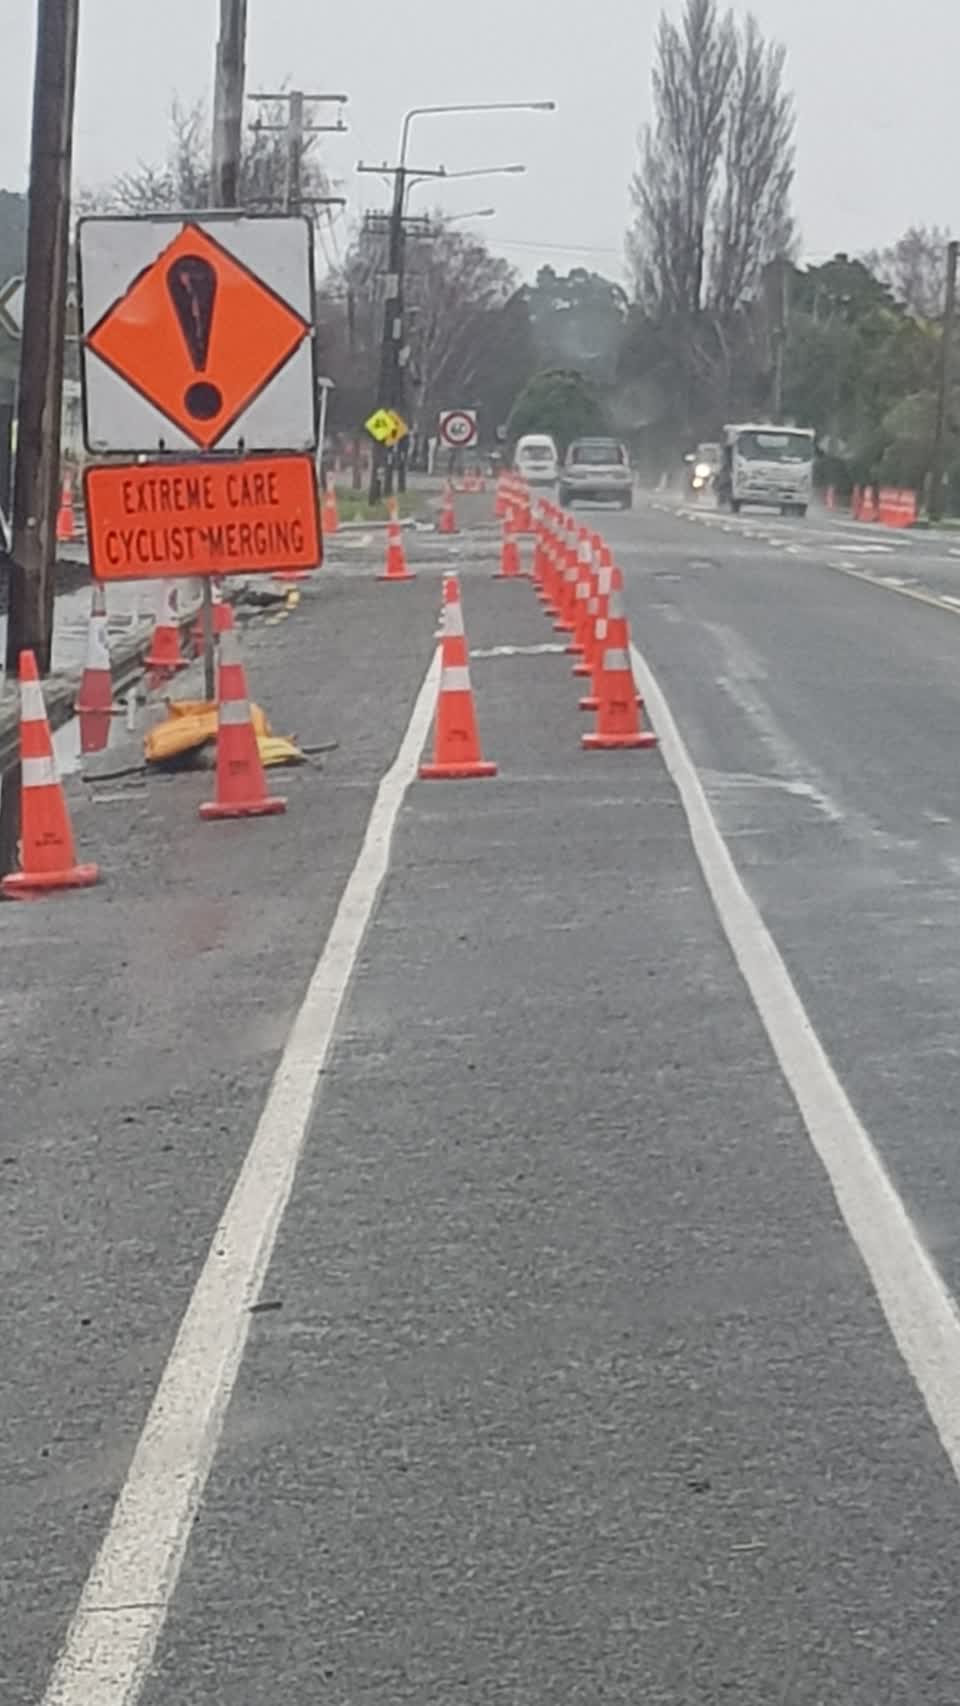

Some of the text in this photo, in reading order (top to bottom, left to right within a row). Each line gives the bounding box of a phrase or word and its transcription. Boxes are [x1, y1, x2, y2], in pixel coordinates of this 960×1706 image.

[122, 472, 280, 514] EXTREME CARE
[105, 519, 304, 565] CYCLIST MERGING
